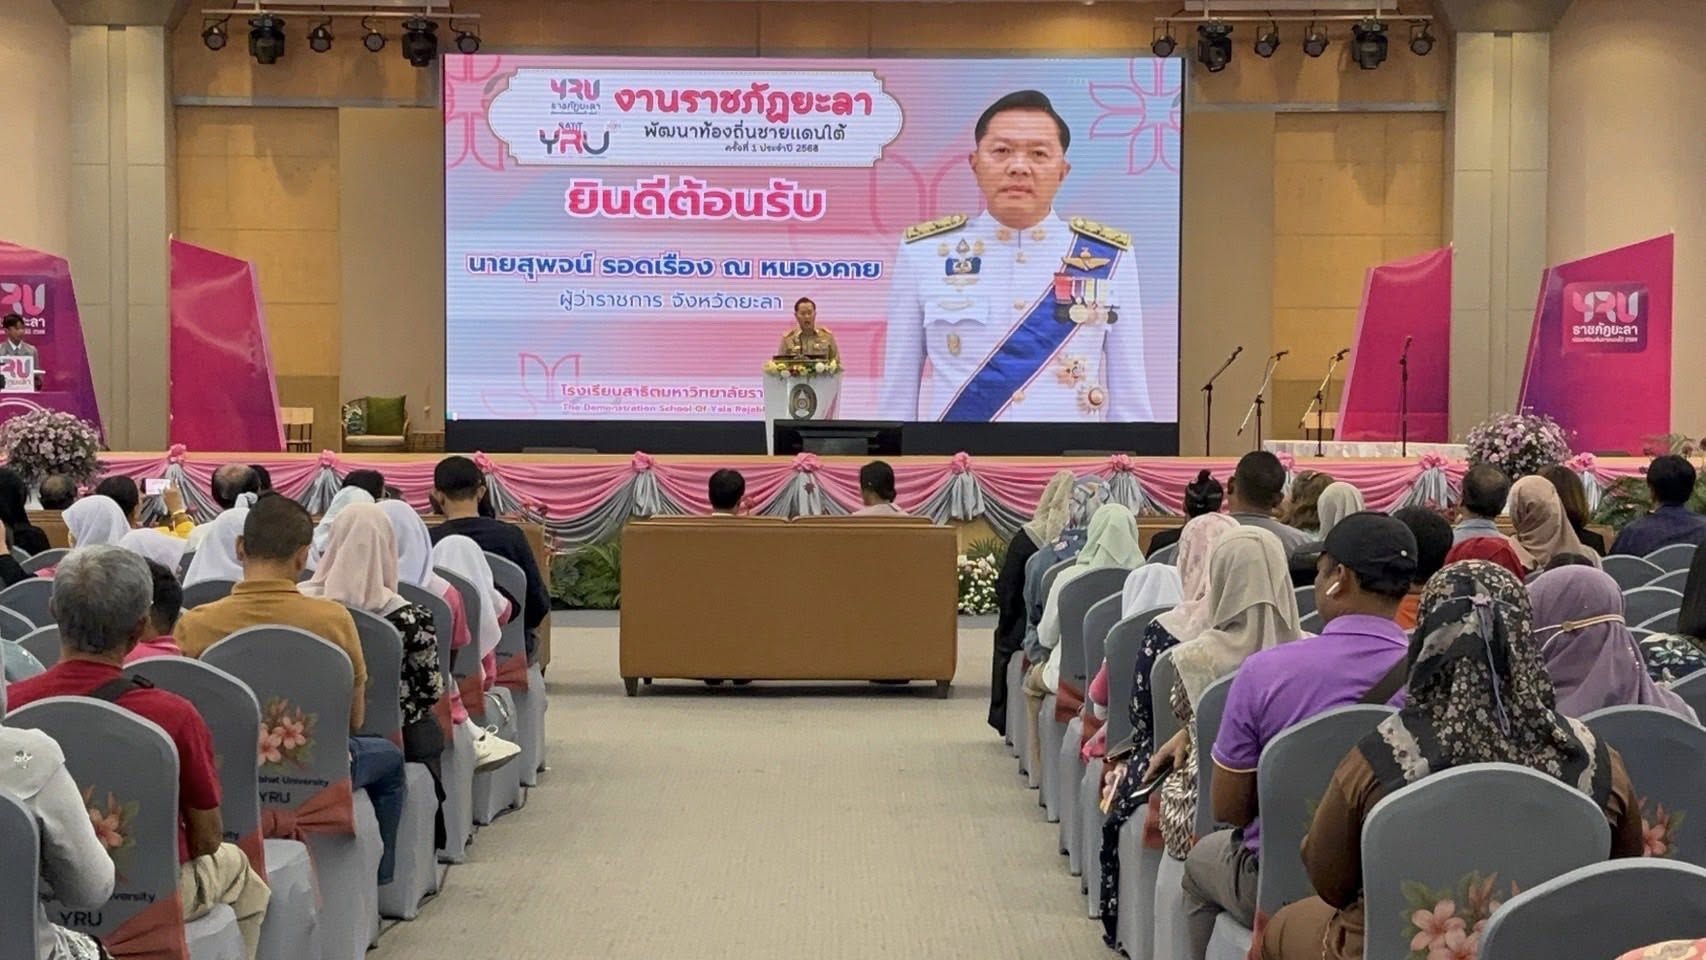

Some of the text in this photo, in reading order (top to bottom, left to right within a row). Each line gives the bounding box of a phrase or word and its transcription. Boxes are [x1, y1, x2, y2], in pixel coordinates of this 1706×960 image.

[550, 78, 601, 101] YRU
[614, 82, 873, 123] งานราชภัฏยะลา
[539, 128, 610, 155] YRU
[644, 120, 846, 141] พัฒนาท้องถิ่นชายแดนใต้
[796, 144, 819, 152] 2568
[567, 178, 823, 218] ยินดีต้อนรับ
[469, 253, 880, 280] นายสุพจน์ รอดเรือง ณ หนองคาย
[0, 283, 45, 316] RU
[560, 290, 782, 311] ผู้ว่าราชการ จังหวัดยะลา
[1573, 291, 1638, 323] YRU
[259, 792, 290, 803] YRU
[60, 911, 102, 926] YRU
